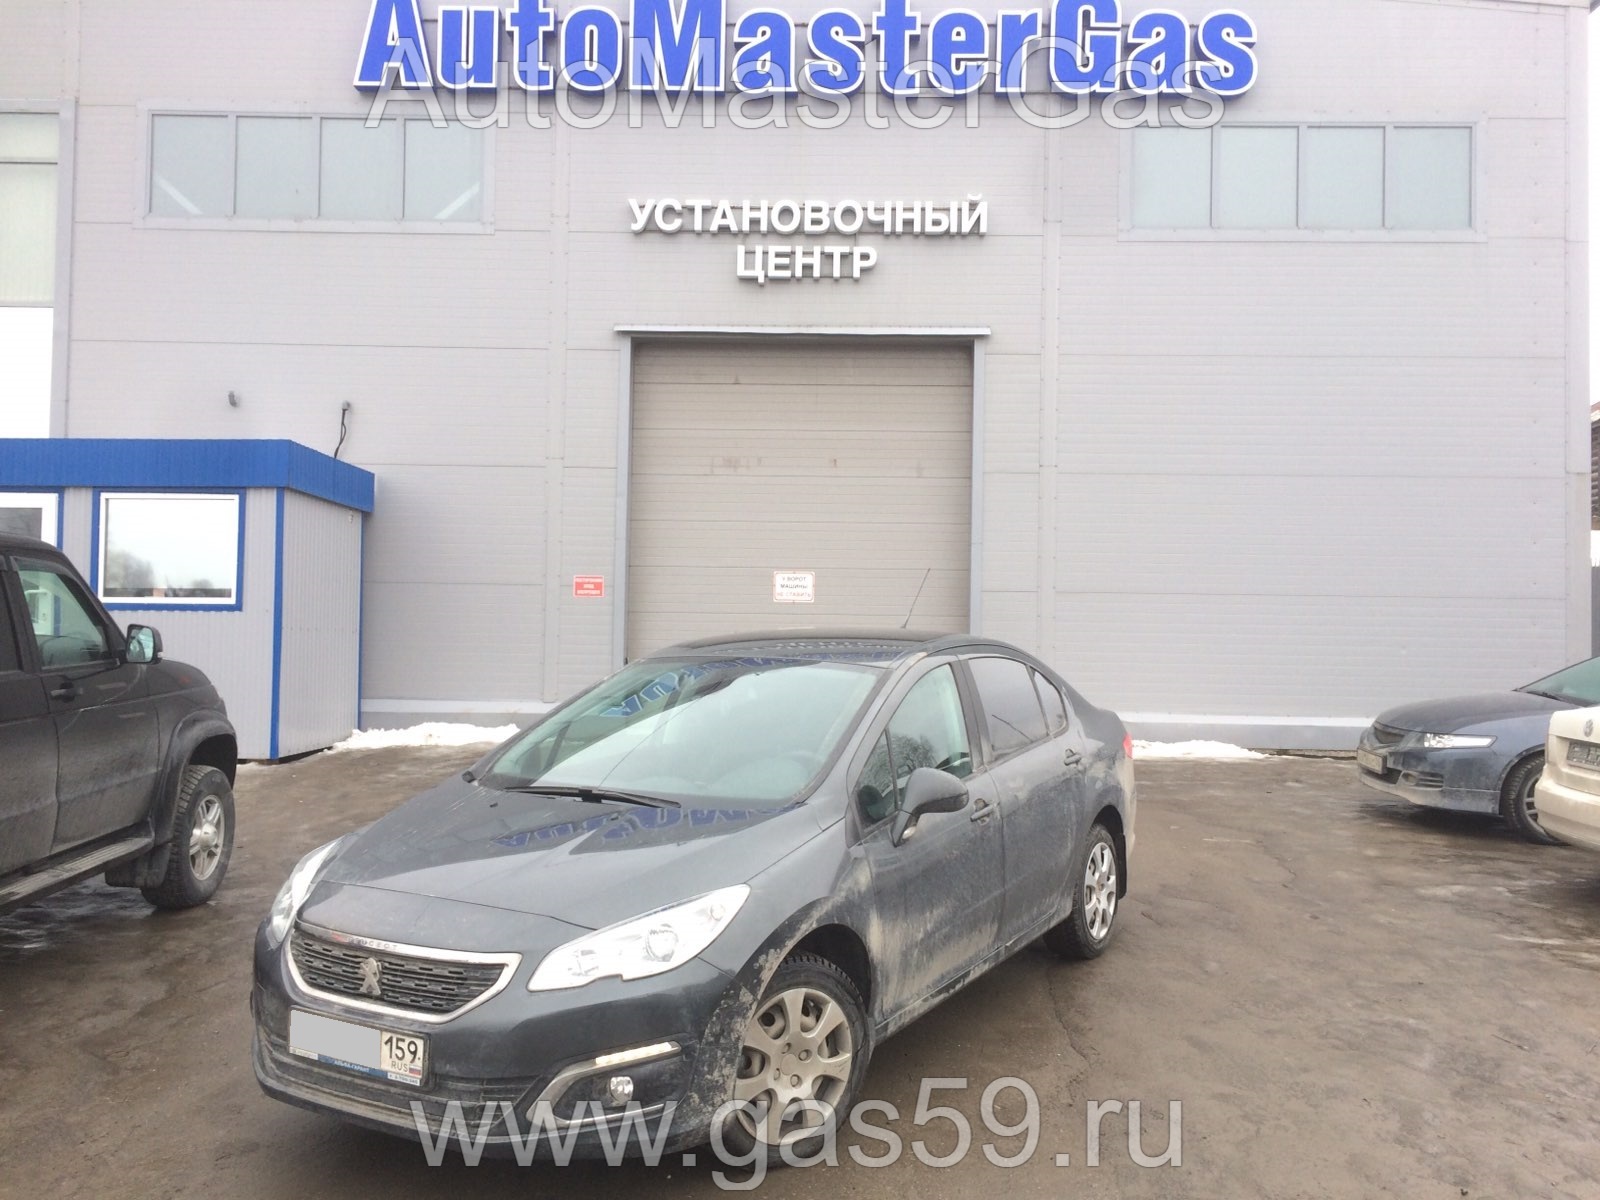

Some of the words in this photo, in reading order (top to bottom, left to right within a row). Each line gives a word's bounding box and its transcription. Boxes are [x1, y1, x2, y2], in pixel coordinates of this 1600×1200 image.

[353, 0, 1259, 97] AutoMasterGas
[628, 193, 989, 237] УСТАНОВОЧНЫЙ
[736, 245, 878, 286] ЦЕНТР
[383, 1035, 419, 1064] 159
[390, 1060, 409, 1073] RUS
